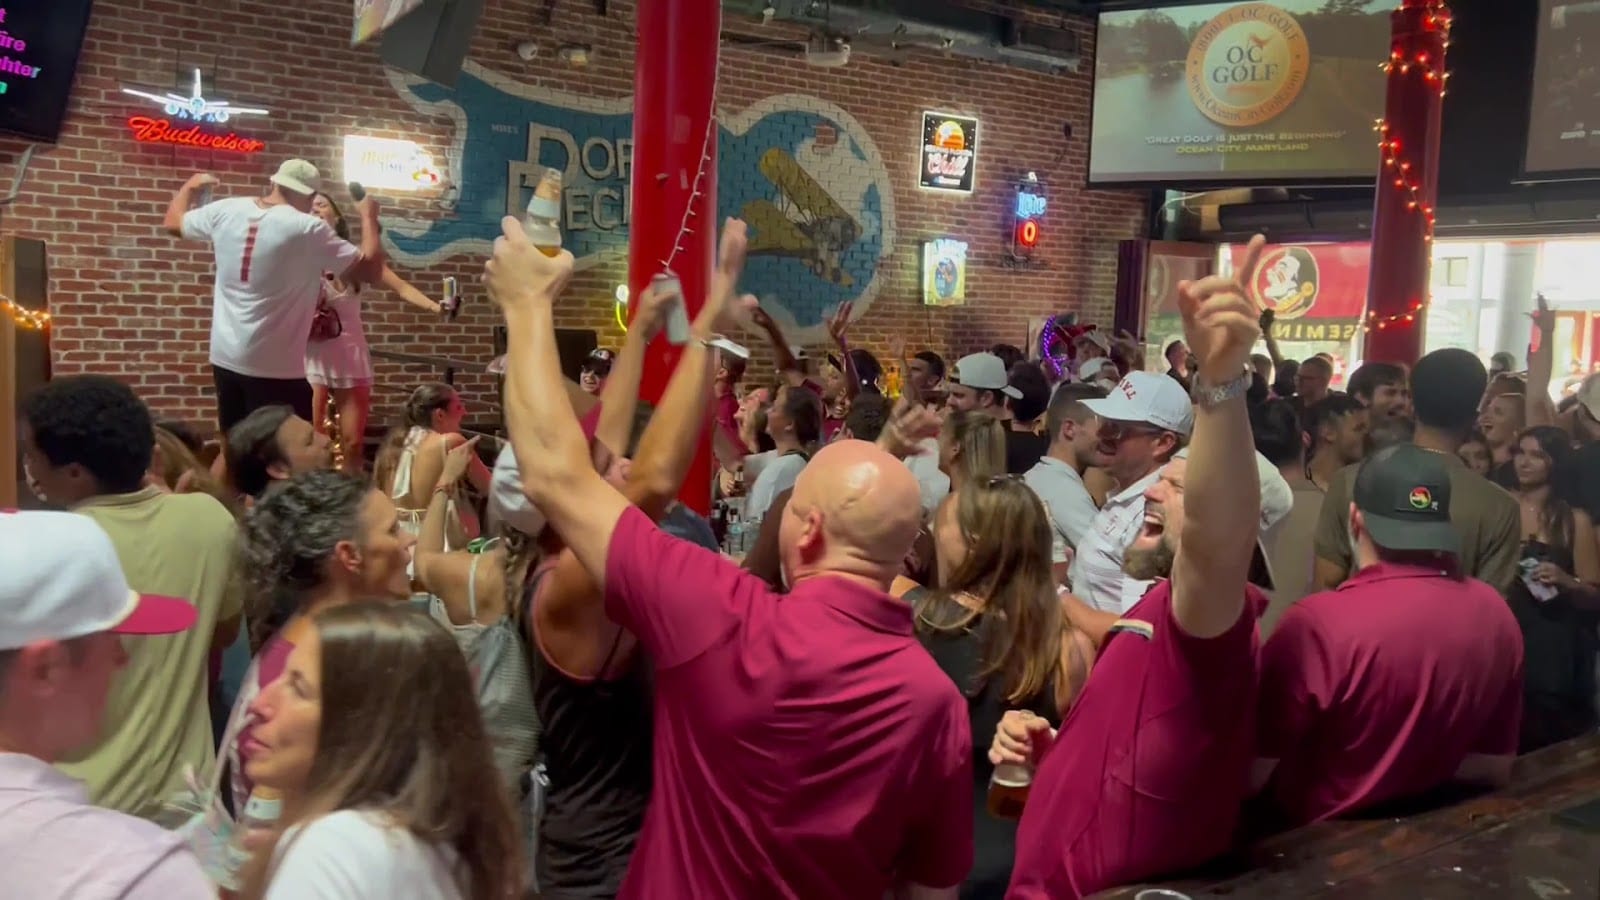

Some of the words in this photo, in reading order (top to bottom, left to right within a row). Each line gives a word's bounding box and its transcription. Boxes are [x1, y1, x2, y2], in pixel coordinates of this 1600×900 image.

[1226, 45, 1263, 64] OC
[1213, 64, 1278, 83] GOLF
[129, 116, 264, 152] Budweiser
[1184, 134, 1212, 143] GOLF
[1176, 145, 1213, 154] OCEAN
[1246, 143, 1309, 152] MARYLAND
